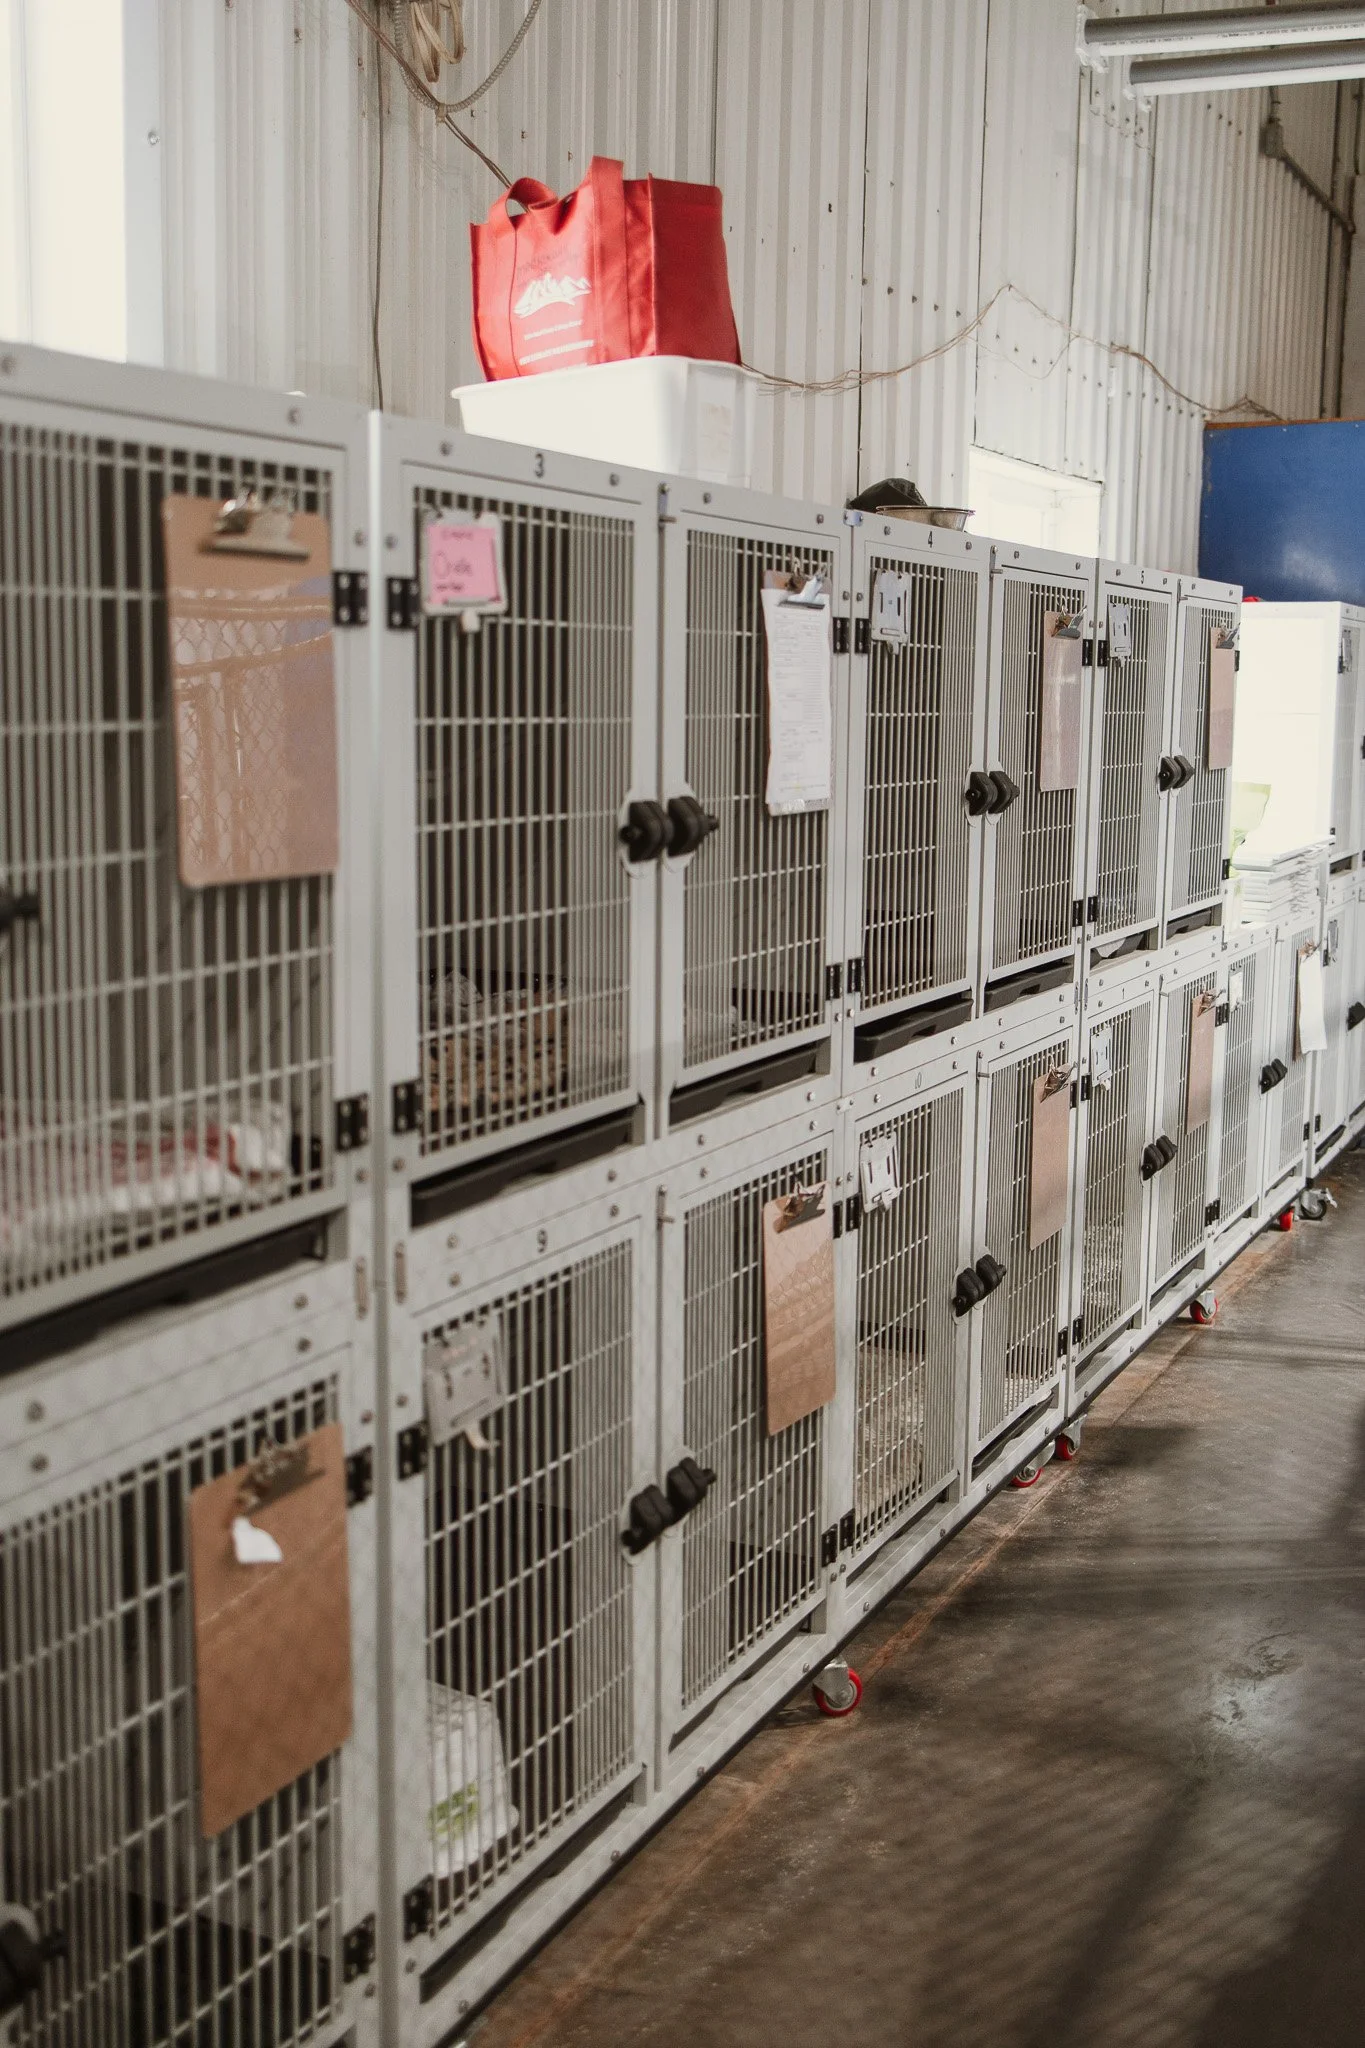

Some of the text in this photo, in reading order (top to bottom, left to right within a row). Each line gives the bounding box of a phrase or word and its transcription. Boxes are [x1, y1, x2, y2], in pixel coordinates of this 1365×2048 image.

[535, 452, 545, 479] 3
[928, 530, 933, 549] 4
[536, 1229, 548, 1254] 9
